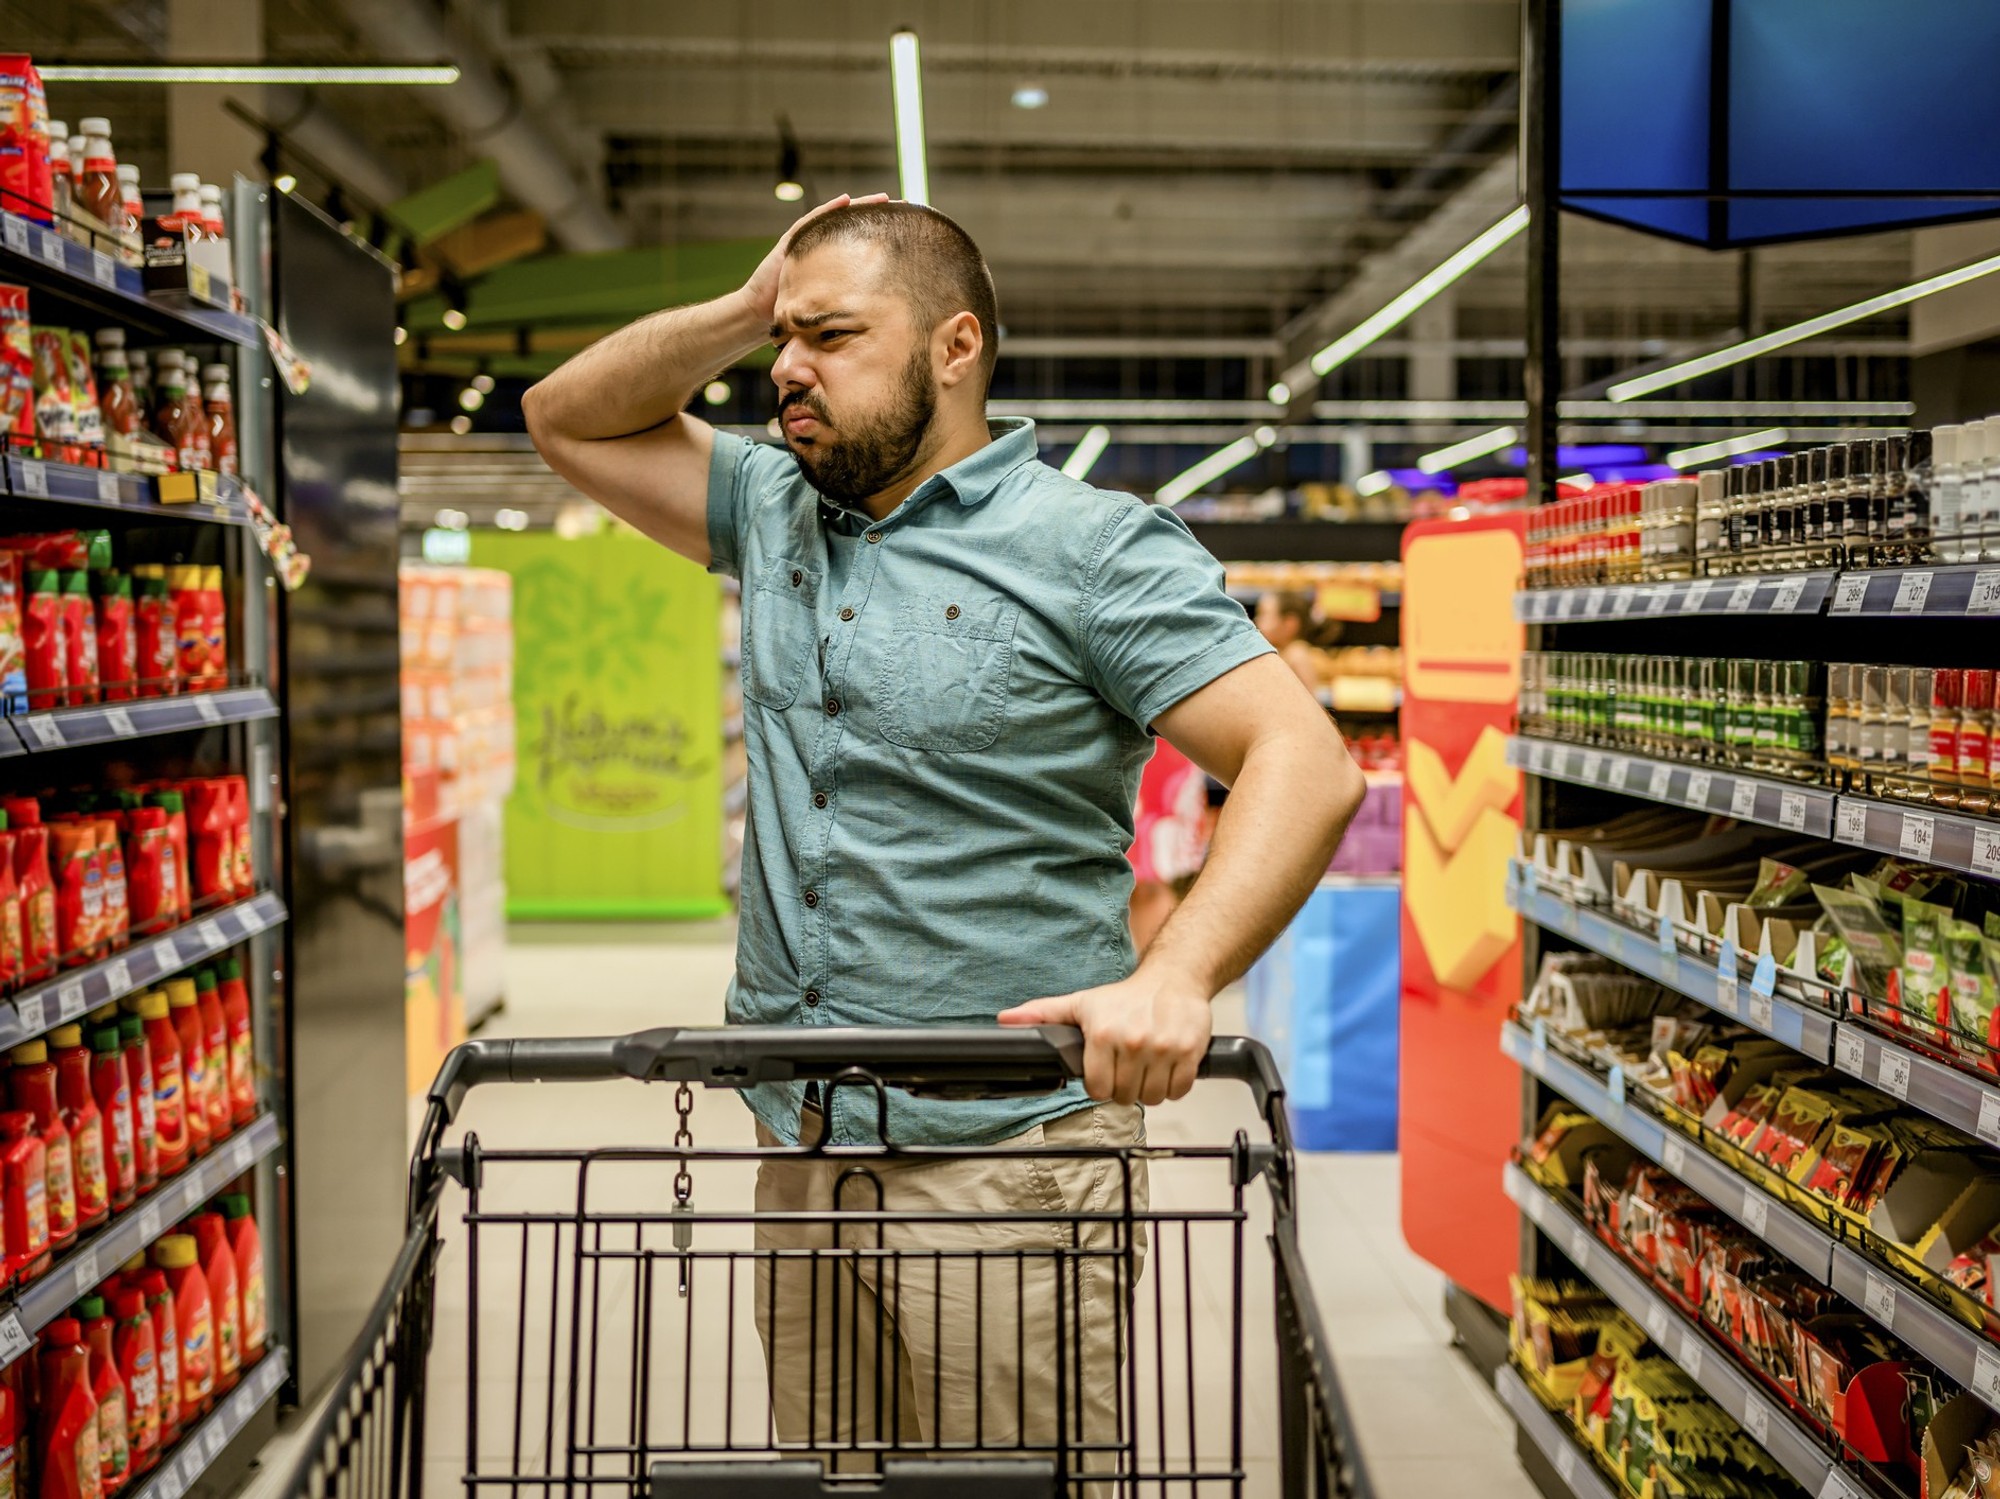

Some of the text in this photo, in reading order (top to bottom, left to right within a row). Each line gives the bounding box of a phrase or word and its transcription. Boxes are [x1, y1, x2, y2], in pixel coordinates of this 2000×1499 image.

[1846, 587, 1862, 602] 299
[1907, 586, 1924, 601] 127
[1789, 803, 1802, 818] 199
[1848, 816, 1861, 832] 199
[1913, 828, 1927, 845] 184
[1850, 1046, 1858, 1063] 93
[1894, 1068, 1904, 1085] 96
[1880, 1295, 1889, 1312] 49
